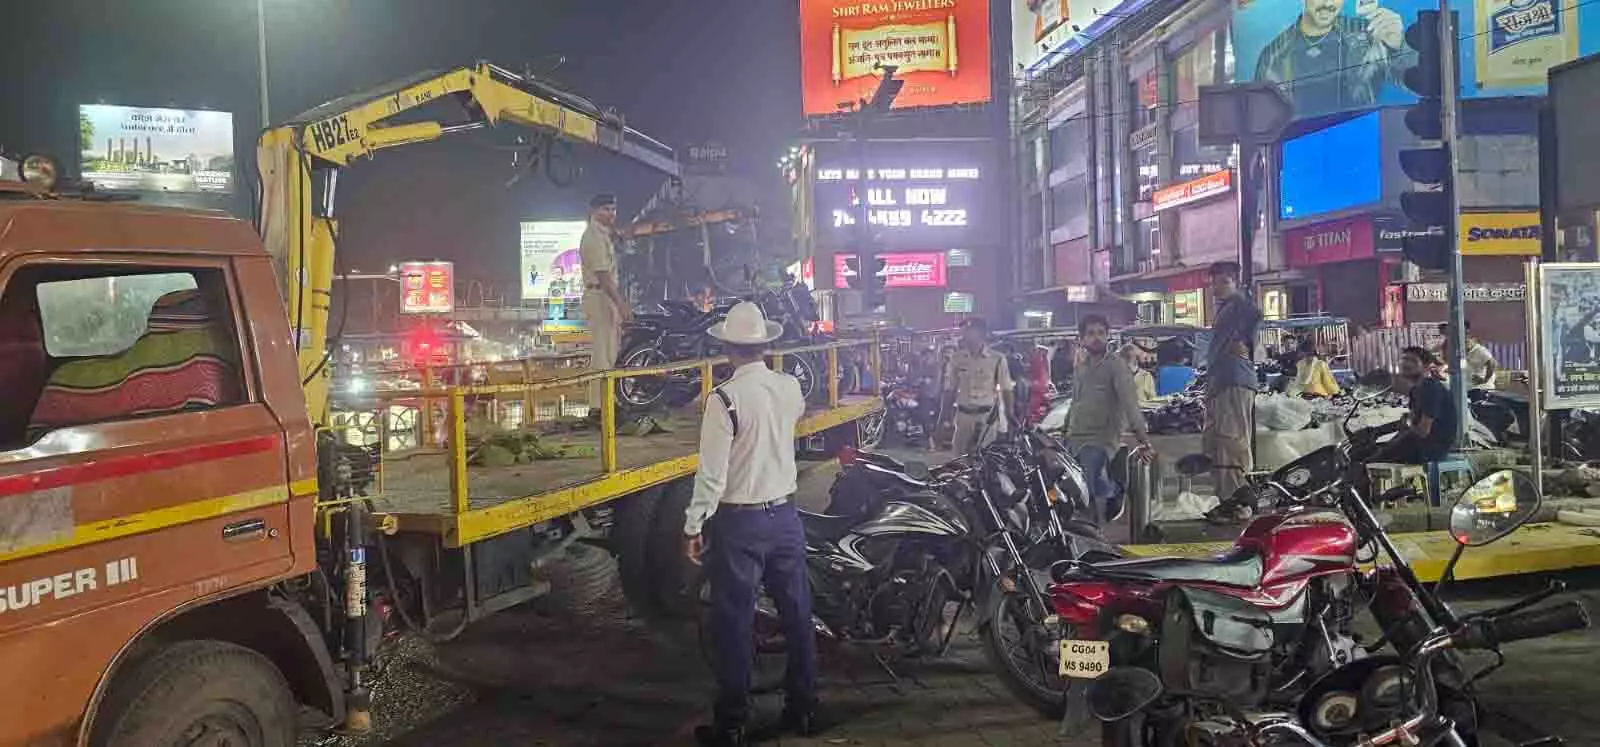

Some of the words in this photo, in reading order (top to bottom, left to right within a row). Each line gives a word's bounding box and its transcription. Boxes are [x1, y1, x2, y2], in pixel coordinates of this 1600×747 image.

[832, 6, 860, 17] SHRI
[862, 3, 889, 15] RAM
[892, 0, 955, 12] JEWELLERS
[311, 114, 351, 153] HB27
[905, 187, 947, 205] NOW
[1318, 229, 1351, 249] TITAN
[1071, 643, 1096, 655] CG04
[1064, 660, 1077, 671] MS
